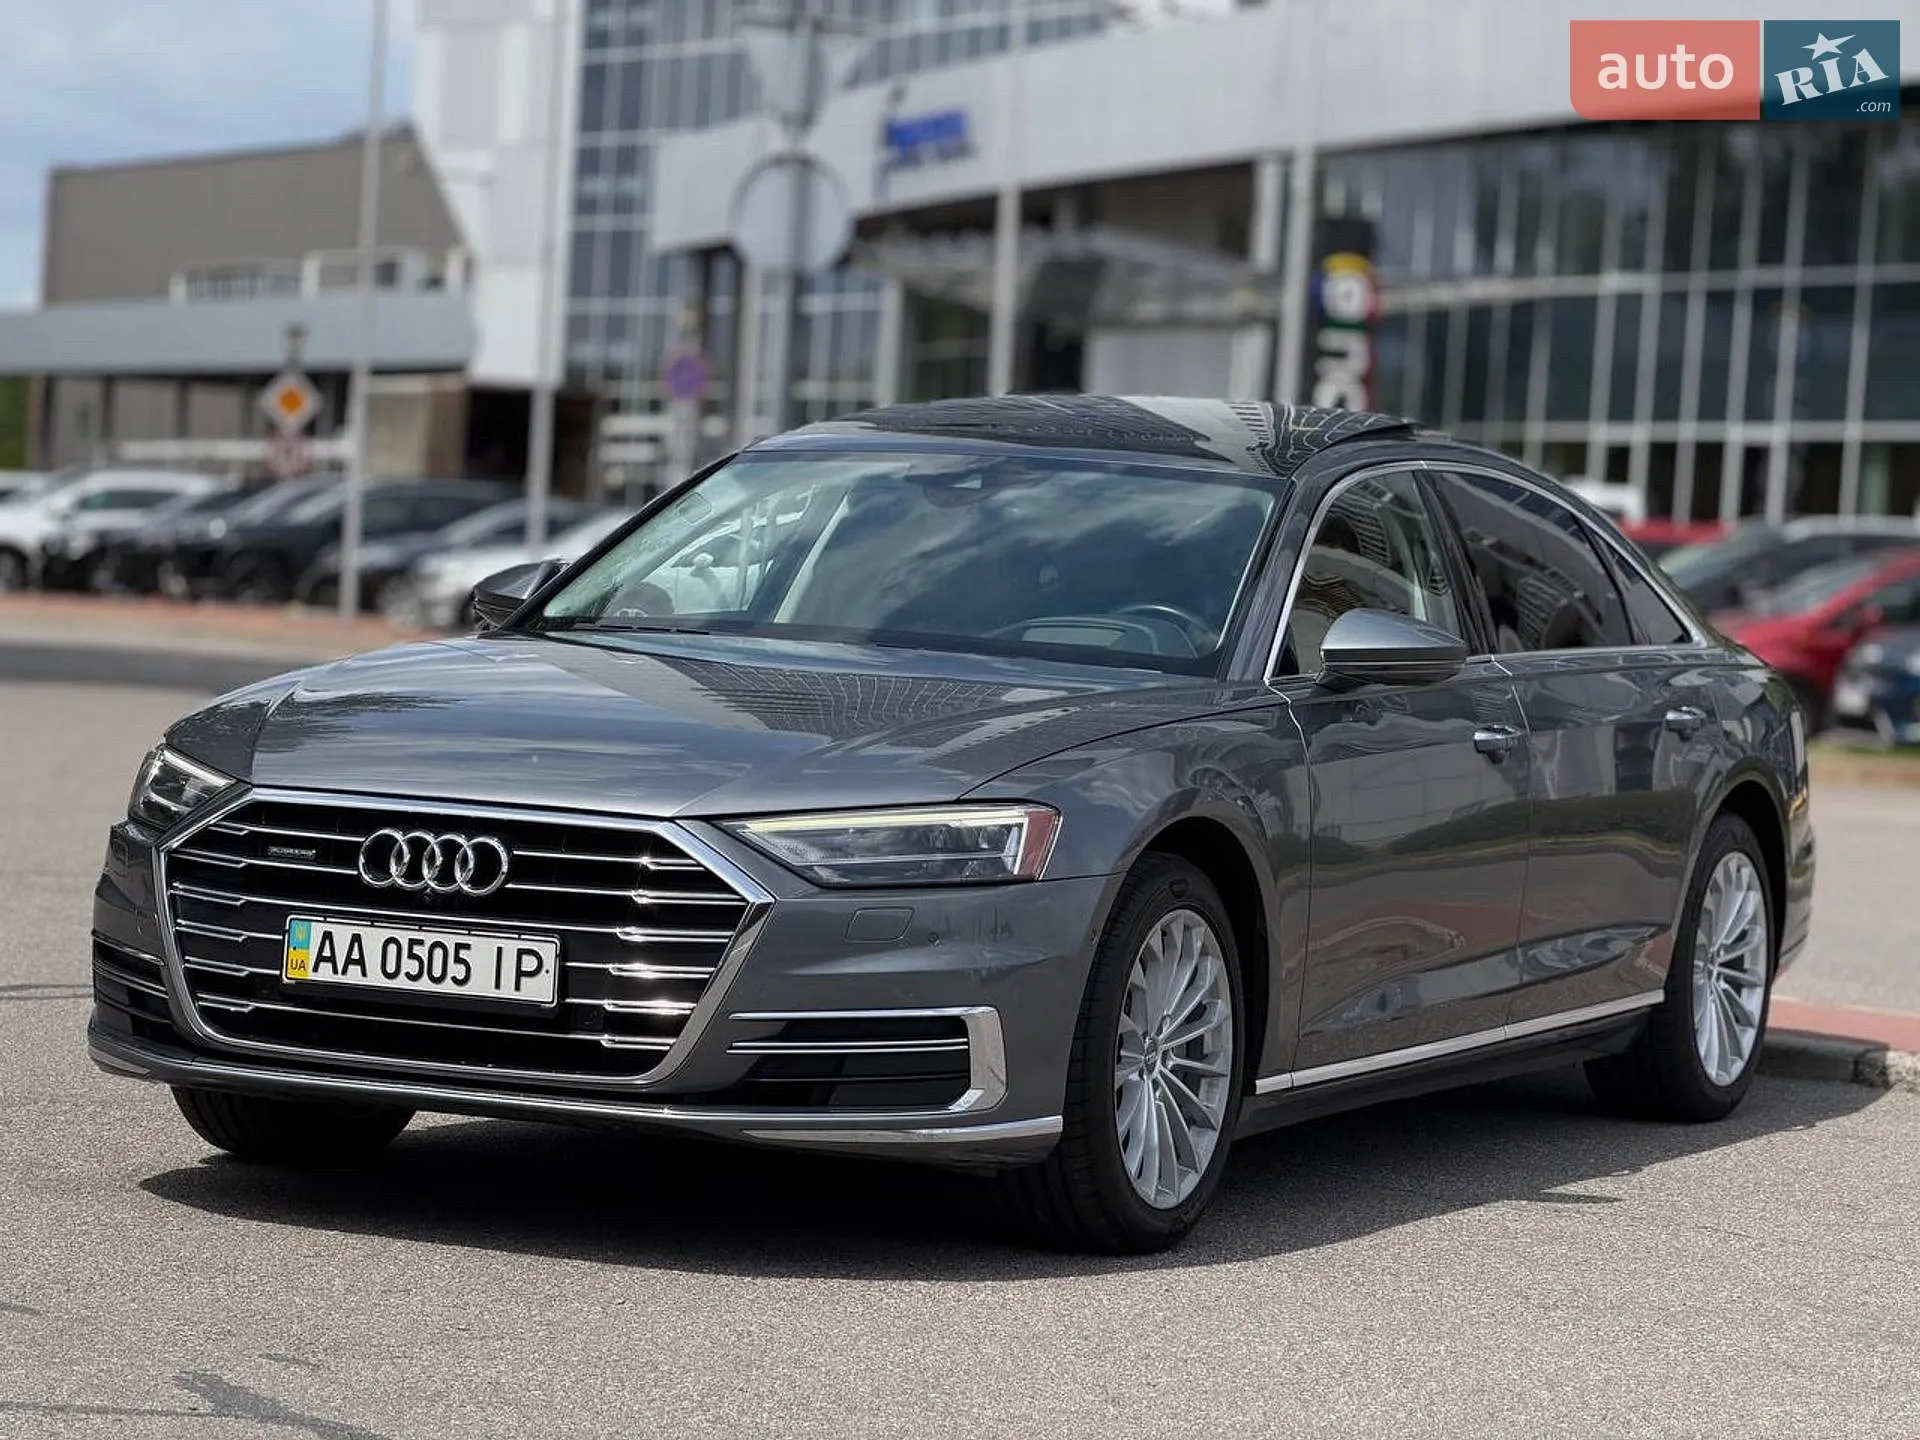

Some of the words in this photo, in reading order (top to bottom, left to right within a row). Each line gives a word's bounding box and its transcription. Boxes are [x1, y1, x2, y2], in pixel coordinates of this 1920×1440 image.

[290, 958, 306, 972] UA
[312, 930, 367, 978] AA
[380, 936, 472, 987] 0505
[493, 946, 544, 992] IP
